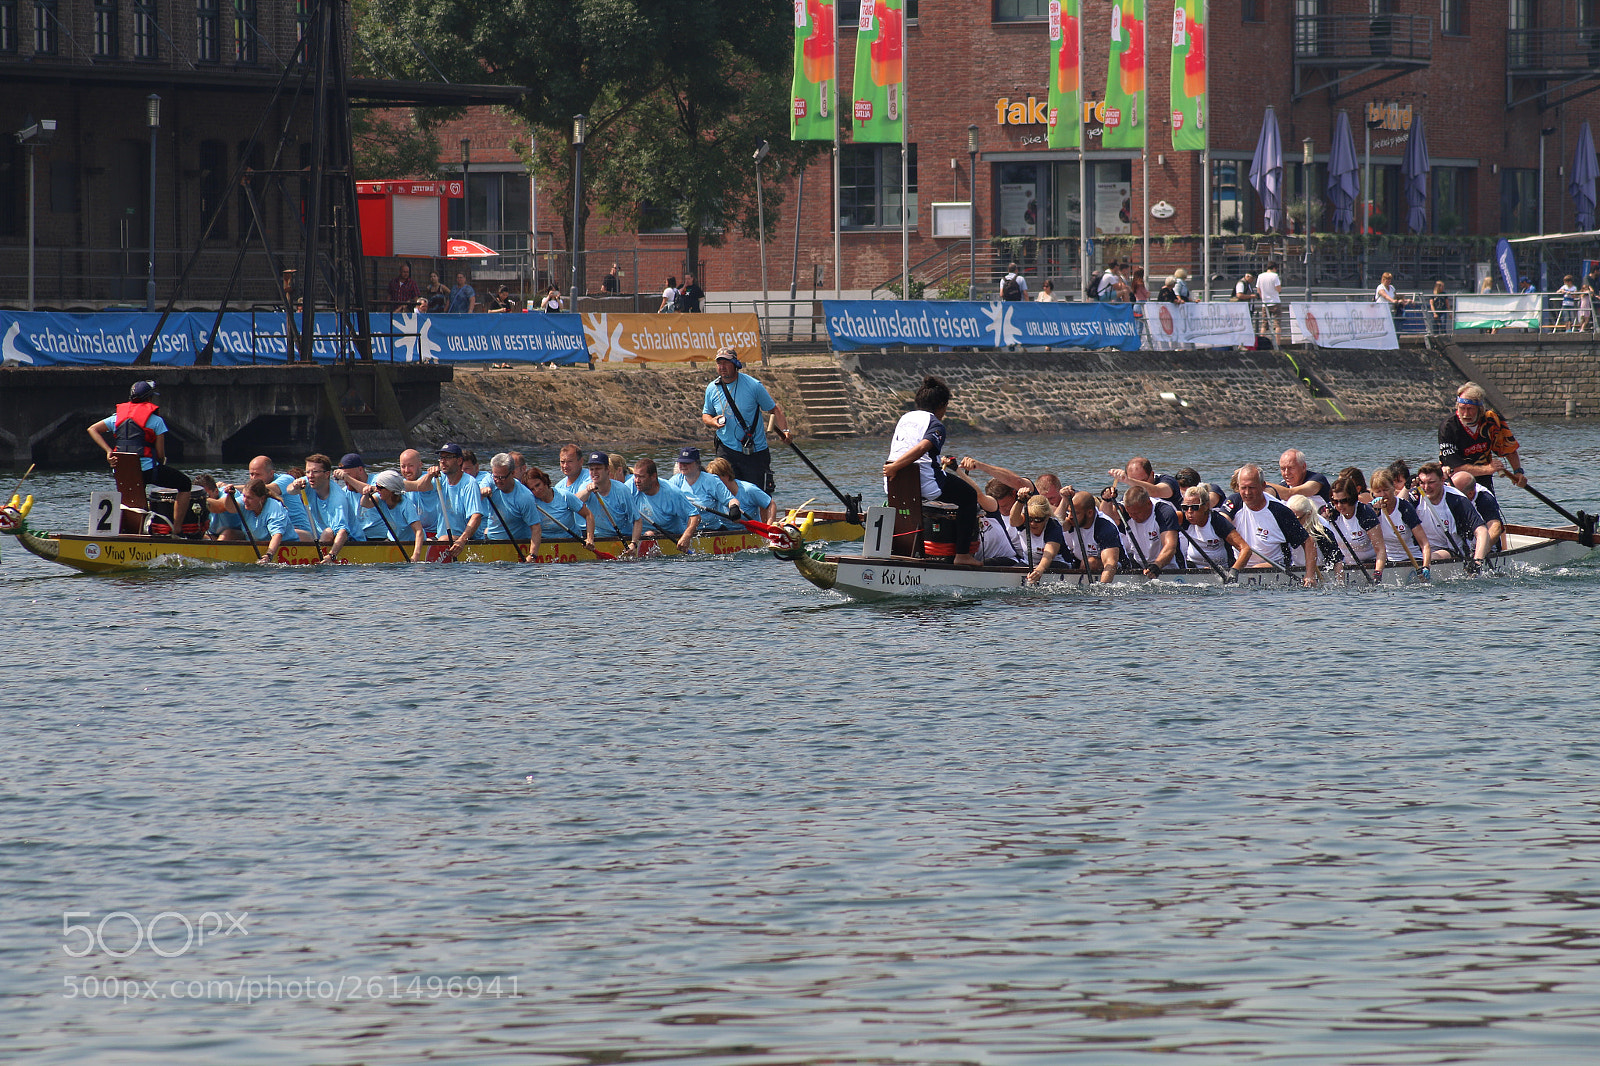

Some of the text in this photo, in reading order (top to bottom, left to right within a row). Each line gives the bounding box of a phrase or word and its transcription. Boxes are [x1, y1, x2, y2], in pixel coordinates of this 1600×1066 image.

[831, 309, 931, 338] schauinsland
[932, 310, 980, 338] reisen
[1025, 321, 1059, 336] URLAUB
[1061, 322, 1070, 336] IN
[30, 327, 138, 353] schauinsland
[447, 331, 584, 352] URLAUB IN BESTEN HÄNDEN
[631, 326, 757, 351] schauinsland reisen
[96, 499, 113, 531] 2
[874, 514, 884, 551] 1
[104, 545, 125, 564] Ying
[518, 543, 578, 564] Snalco
